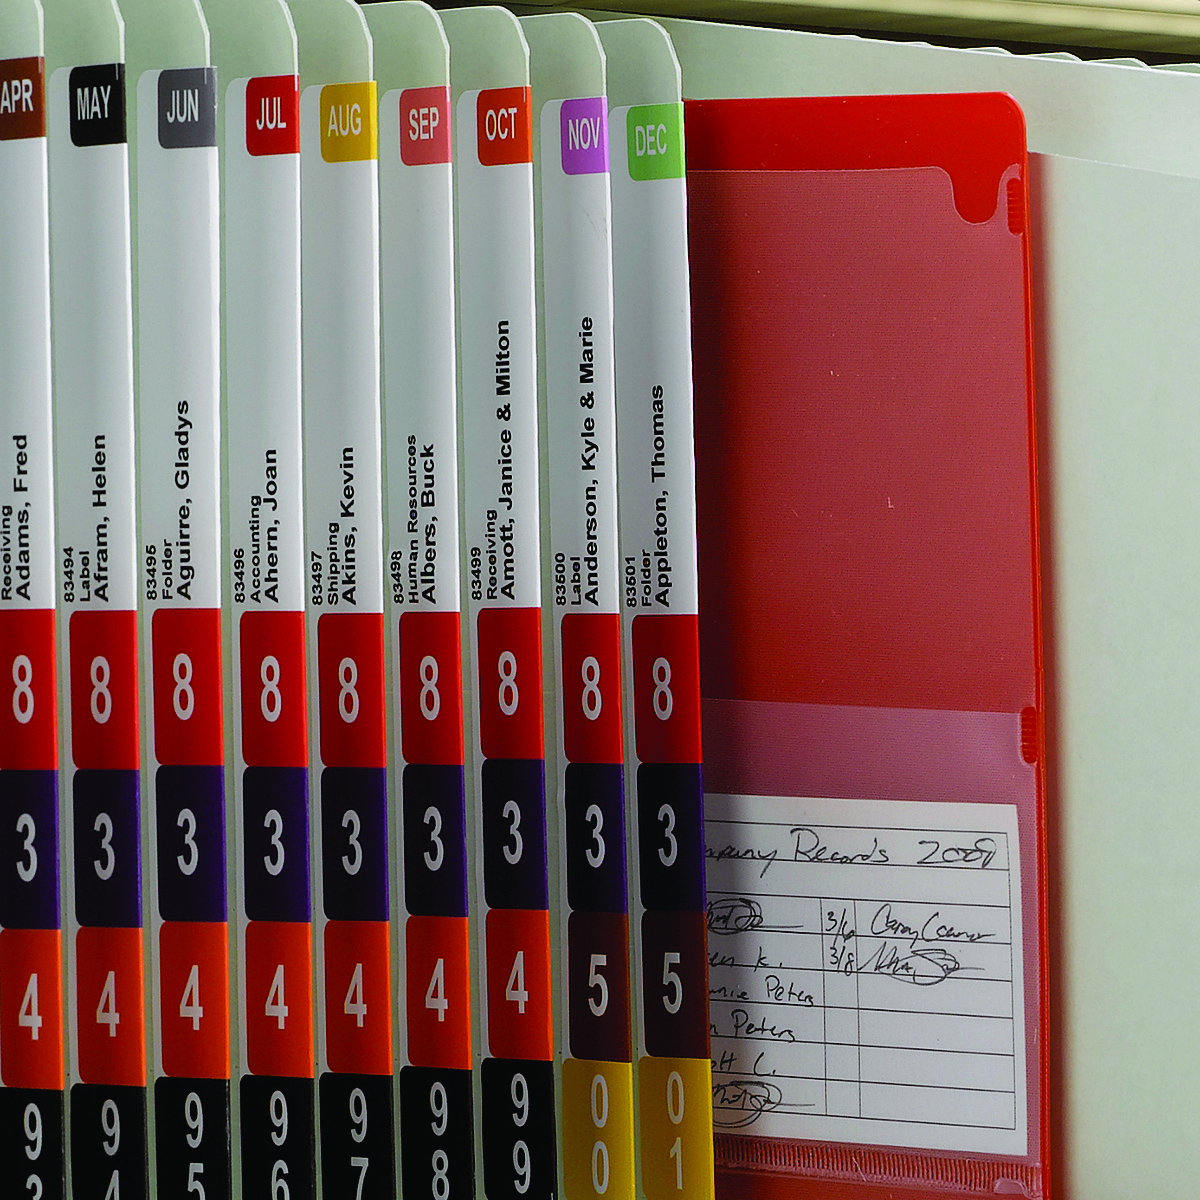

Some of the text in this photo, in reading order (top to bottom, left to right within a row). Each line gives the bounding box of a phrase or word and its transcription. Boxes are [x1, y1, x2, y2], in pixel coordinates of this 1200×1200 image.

[1, 79, 33, 114] APR
[77, 85, 111, 120] MAY
[167, 89, 198, 122] JUN
[256, 97, 286, 130] JUL
[329, 104, 361, 136] AUG
[410, 107, 439, 140] SEP
[486, 108, 517, 140] OCT
[569, 117, 600, 150] NOV
[636, 124, 667, 156] DEC
[579, 317, 598, 606] Anderson, Kyle & Marie
[13, 435, 30, 600] Adams, Fred
[92, 435, 110, 602] Afram, Helen
[175, 401, 194, 600] Aguirre, Gladys
[263, 450, 280, 603] Ahern, Joan
[340, 448, 357, 605] Akins, Kevin
[408, 435, 419, 603] Human Resources
[420, 444, 438, 604] Albers, Buck
[651, 385, 672, 607] Appleton, Thomas
[63, 547, 74, 602] 83494
[234, 548, 245, 603] 83496
[250, 496, 261, 603] Accounting
[327, 523, 340, 605] Shipping
[471, 547, 482, 600] 83499
[485, 510, 497, 599] Receiving
[625, 557, 637, 607] 83501
[12, 654, 35, 724] 8
[17, 814, 37, 881] 3
[19, 974, 42, 1040] 4
[185, 1092, 203, 1148] 9
